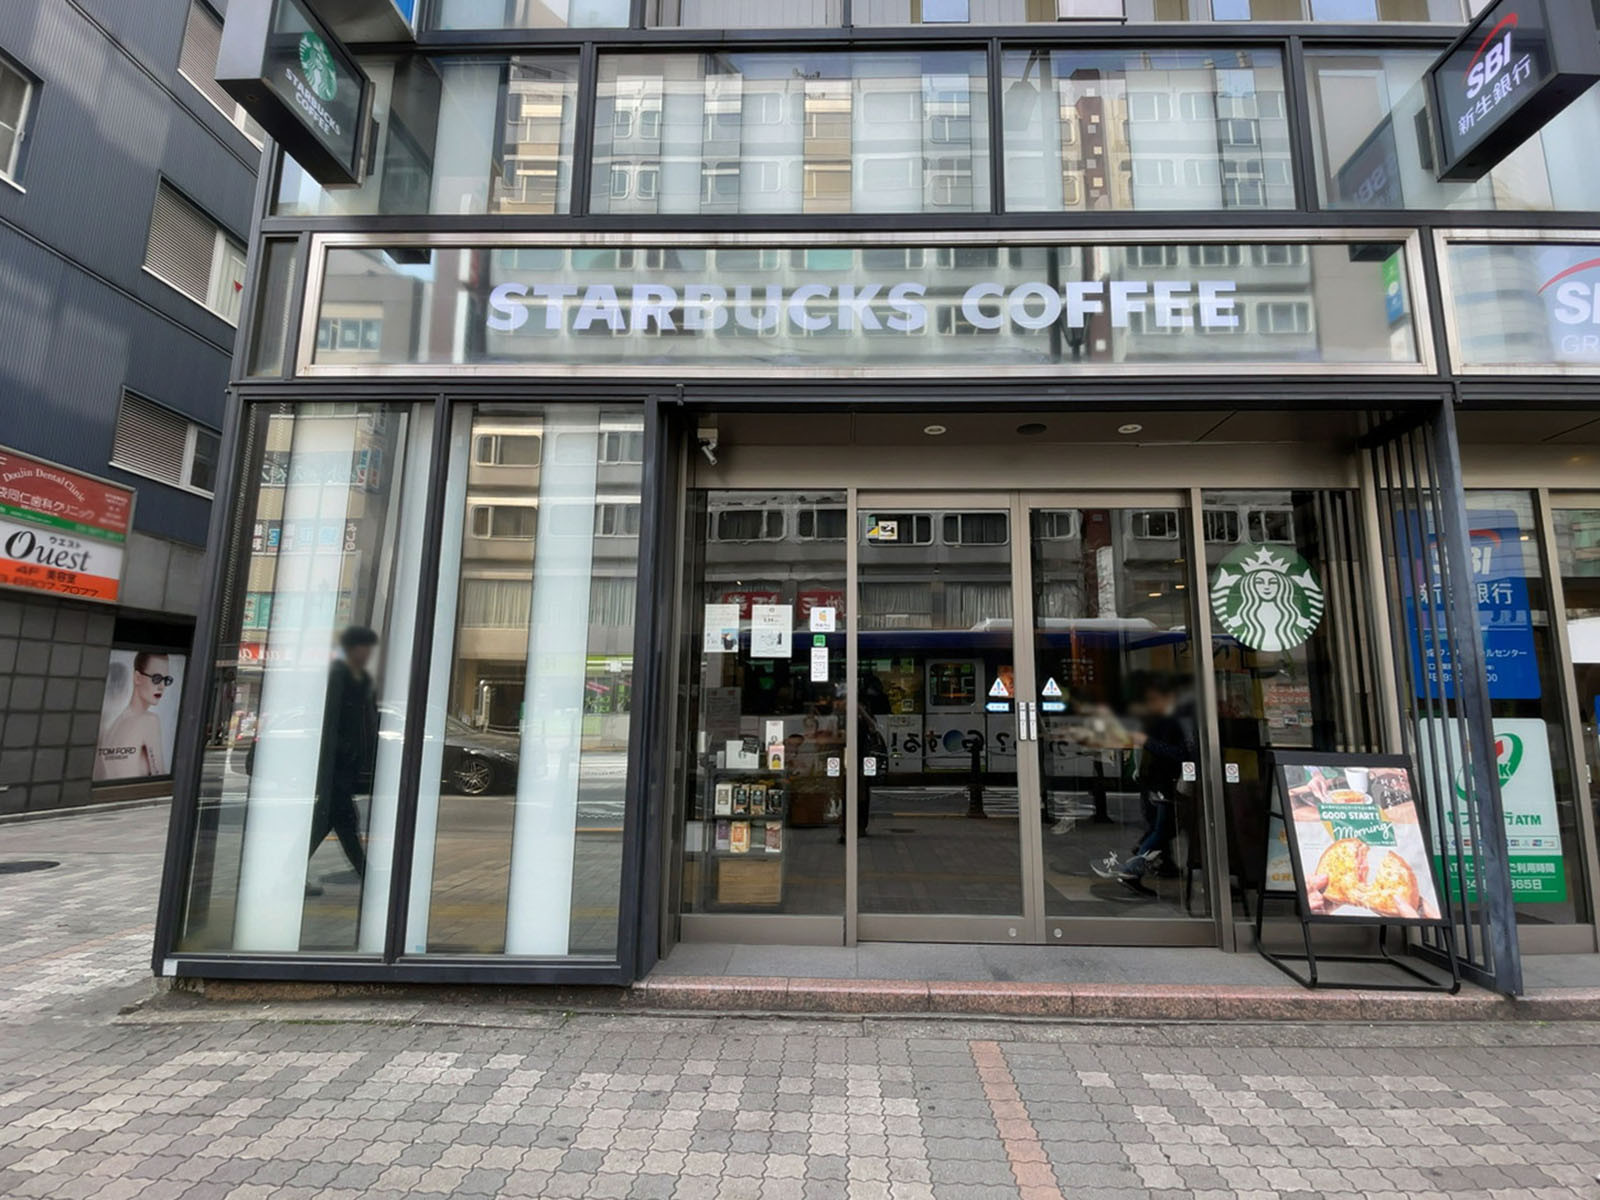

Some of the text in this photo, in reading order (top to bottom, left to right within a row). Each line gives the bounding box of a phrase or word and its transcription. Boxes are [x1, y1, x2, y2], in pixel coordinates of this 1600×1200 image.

[1466, 31, 1511, 99] SBI
[285, 67, 341, 136] STARBUCKS
[1458, 54, 1531, 136] 新生銀行
[295, 91, 330, 135] COFFEE
[483, 281, 1239, 331] STARBUCKS COFFEE
[2, 467, 33, 482] Doujin
[36, 468, 65, 486] Dental
[64, 480, 86, 503] Clinic
[49, 536, 81, 549] ウエスト
[16, 565, 40, 575] 4F
[1418, 582, 1513, 605] 新銀行
[98, 746, 137, 756] TOM FORD
[1322, 811, 1346, 819] GOOD
[1334, 821, 1392, 839] Morning
